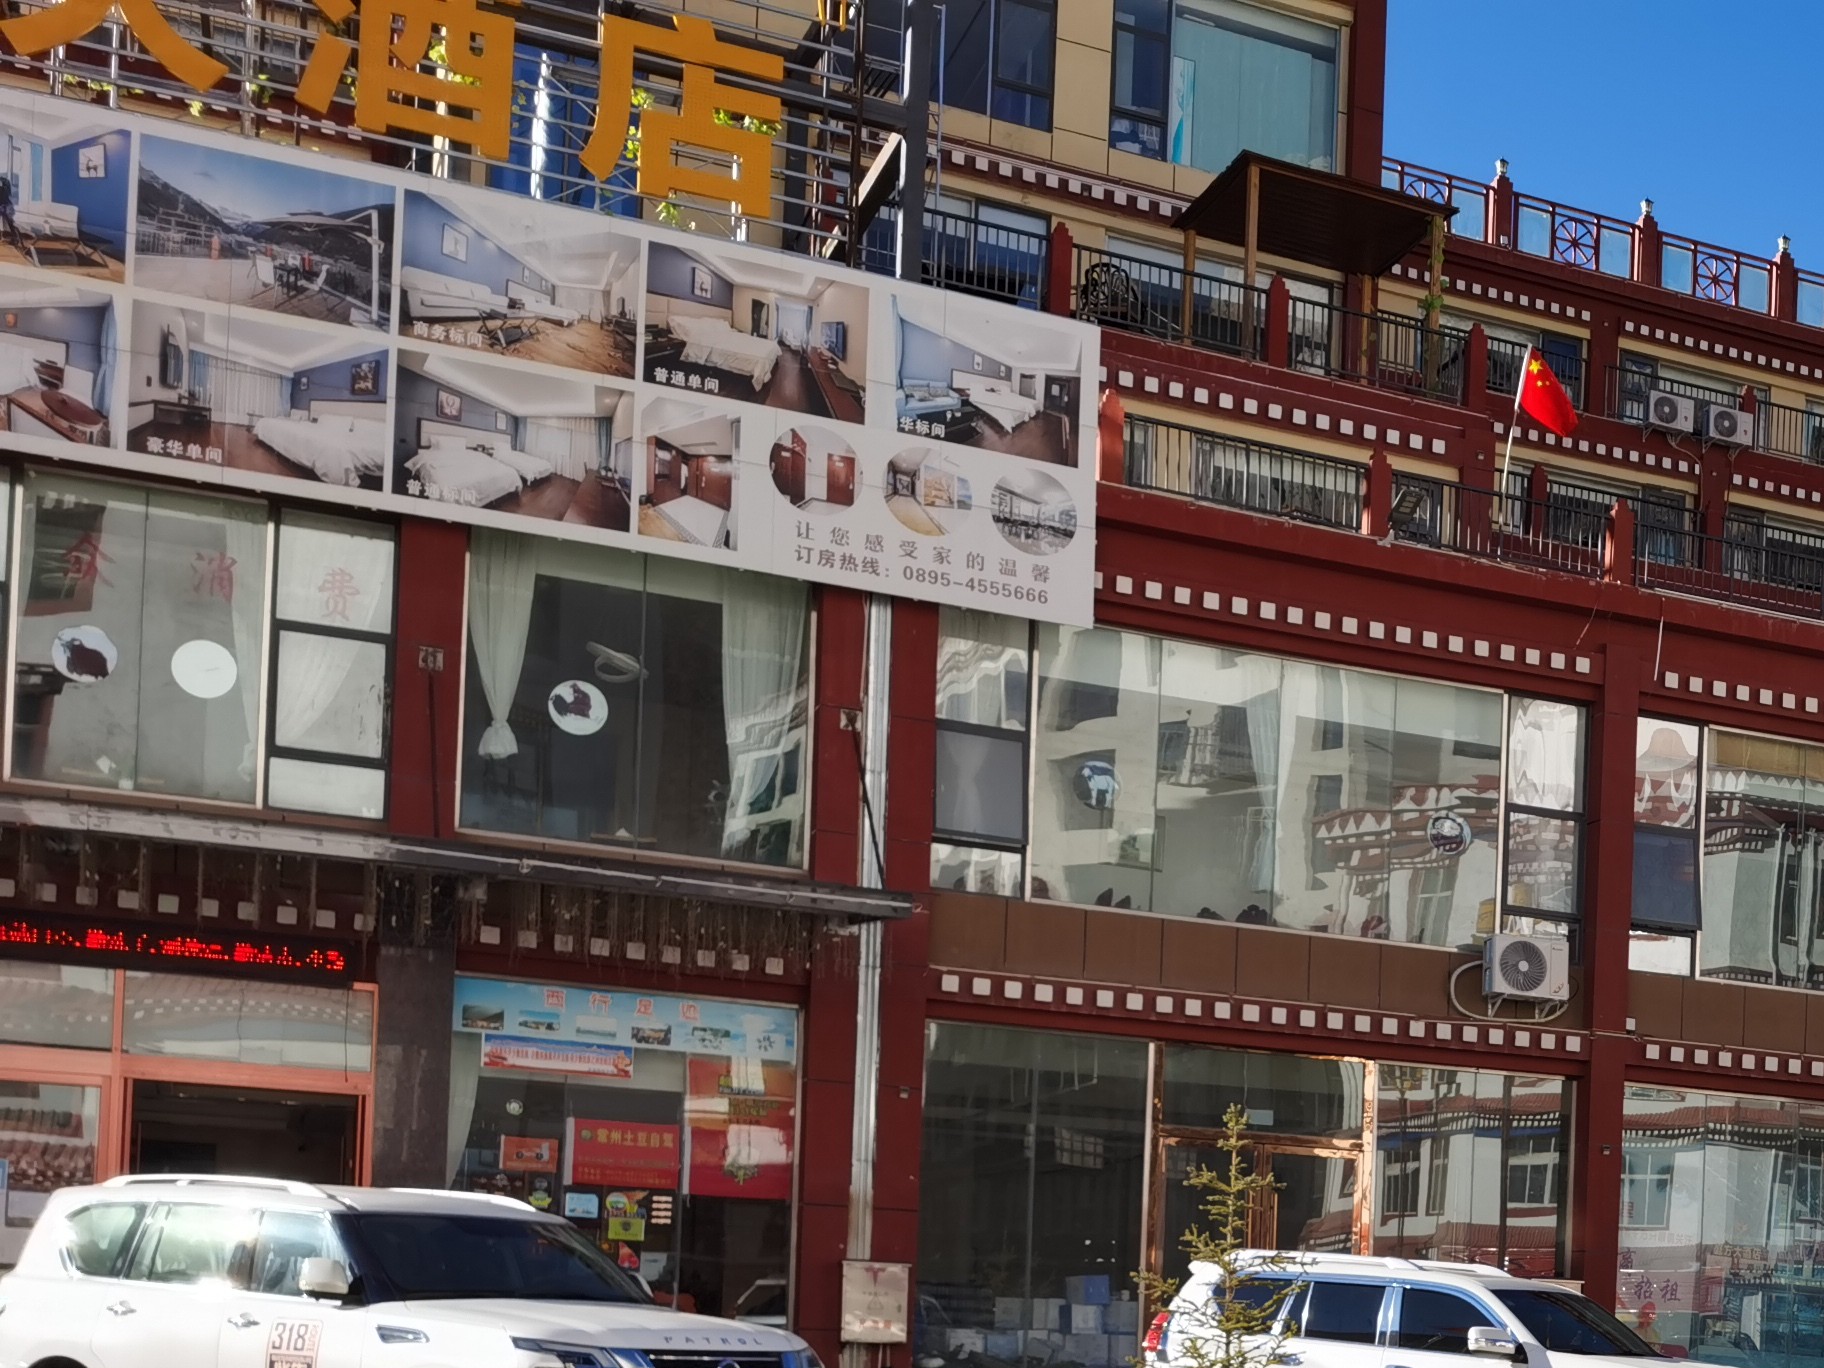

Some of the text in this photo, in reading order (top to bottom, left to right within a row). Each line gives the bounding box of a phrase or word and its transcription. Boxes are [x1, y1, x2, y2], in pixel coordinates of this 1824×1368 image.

[412, 321, 484, 347] 商务标间
[653, 367, 720, 393] 普通单间
[146, 436, 223, 463] 豪华单间
[406, 480, 477, 505] 普通标间
[795, 520, 1051, 585] 让您感受家的温馨
[1634, 1275, 1681, 1303] 招租
[271, 1322, 309, 1351] 318
[663, 1335, 763, 1347] PATROL
